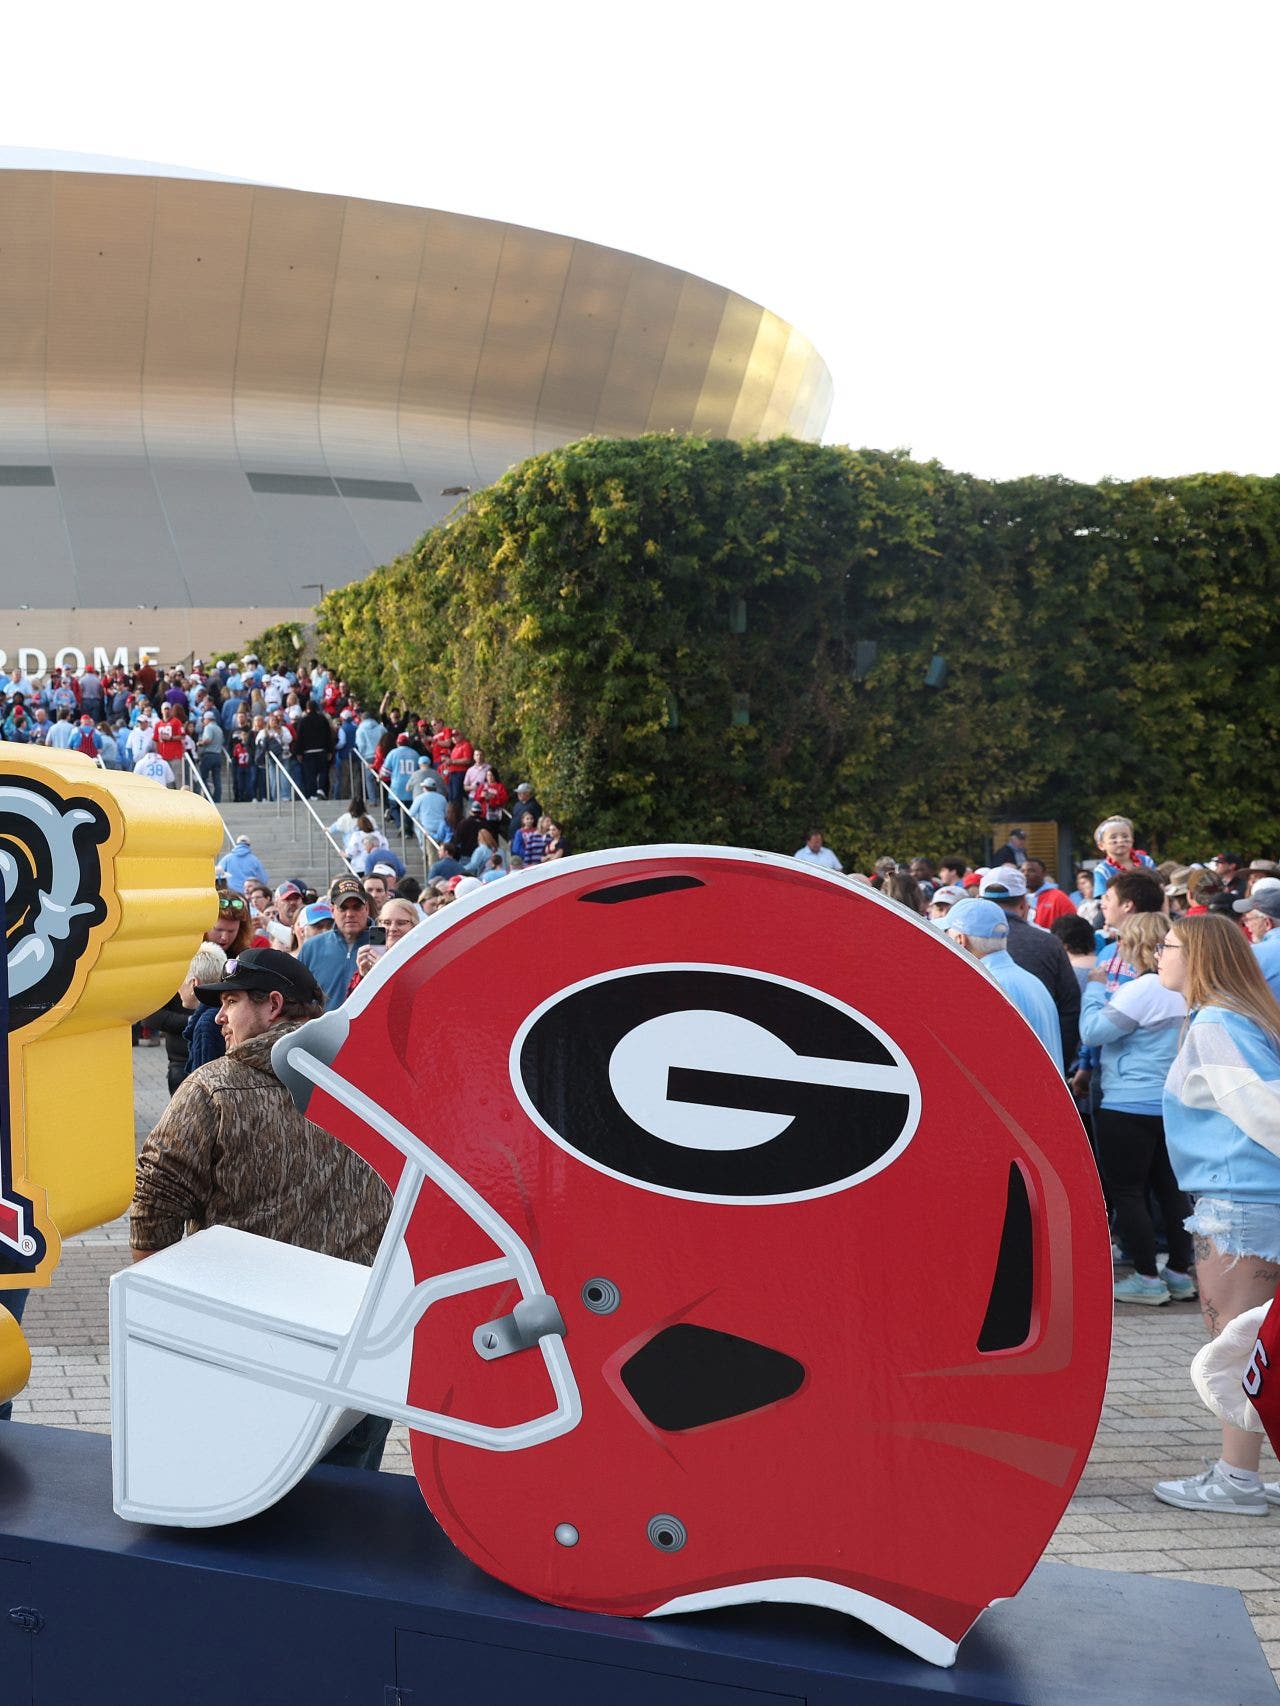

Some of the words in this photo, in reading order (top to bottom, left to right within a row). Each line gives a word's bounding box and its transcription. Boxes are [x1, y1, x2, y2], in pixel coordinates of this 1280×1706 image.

[146, 764, 163, 776] 38
[399, 759, 415, 775] 10
[515, 967, 916, 1200] G
